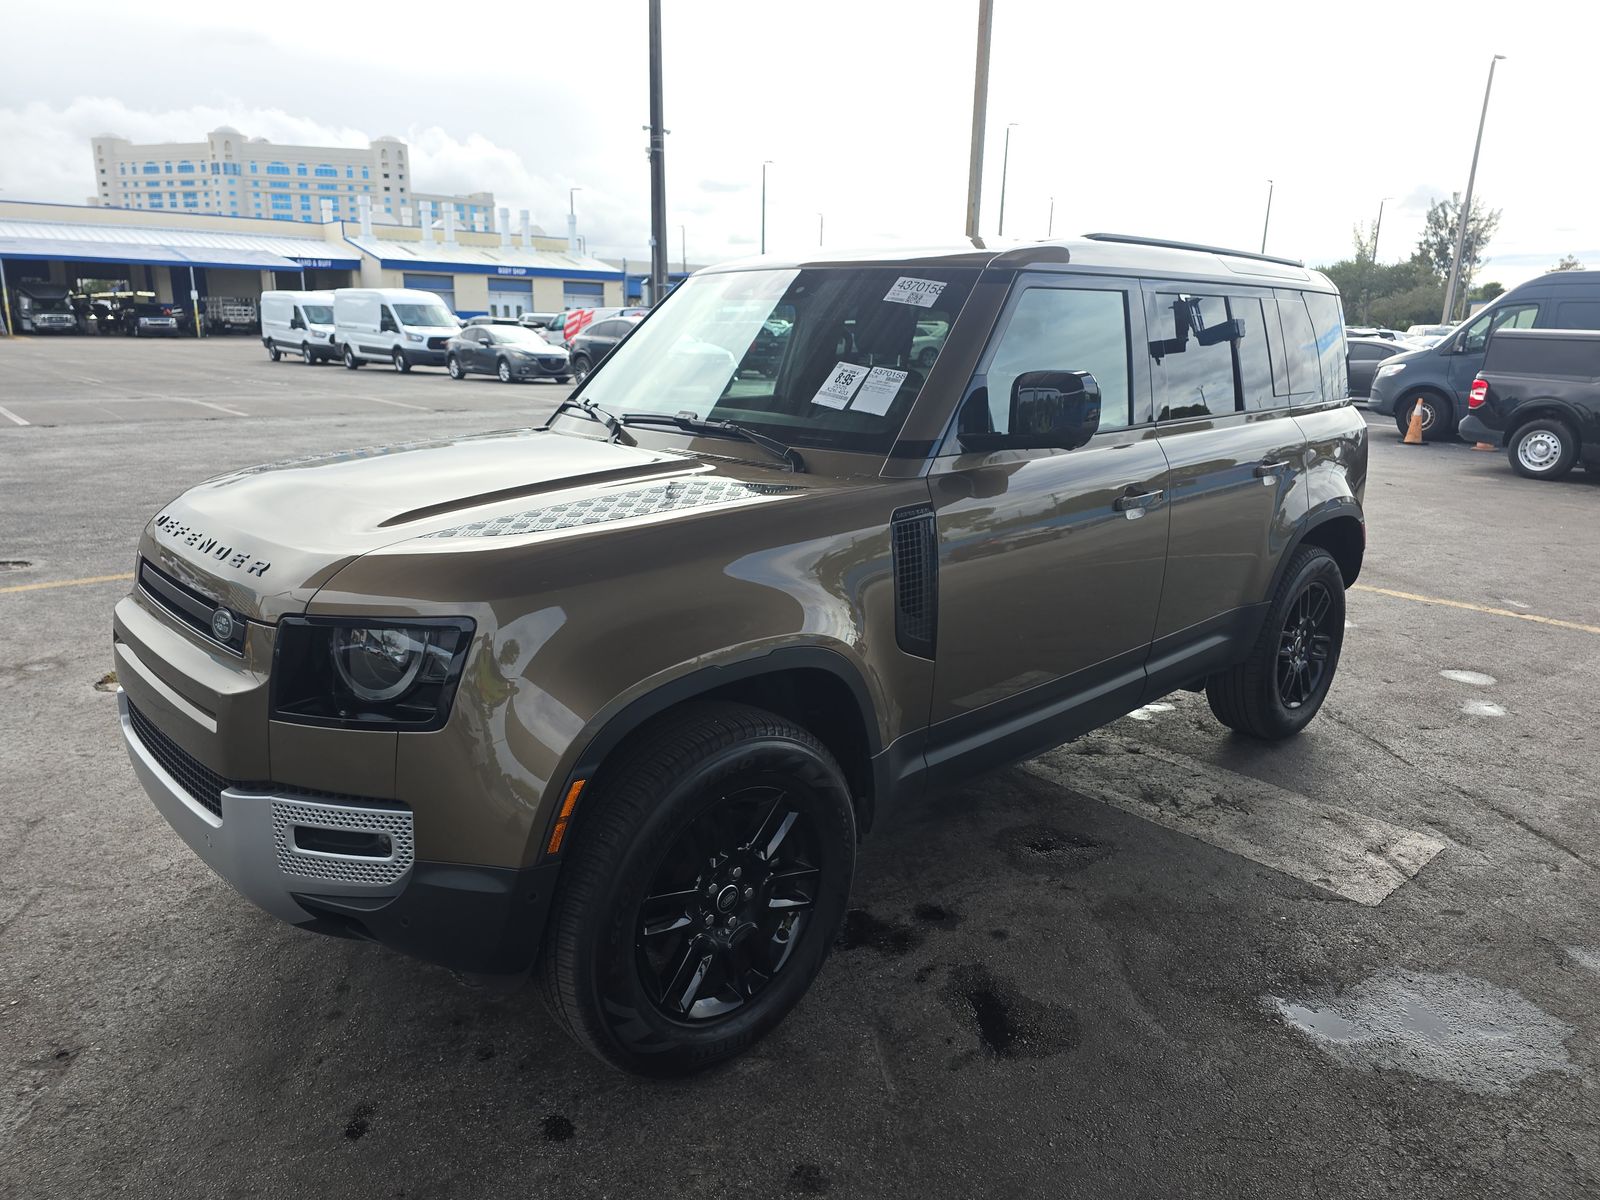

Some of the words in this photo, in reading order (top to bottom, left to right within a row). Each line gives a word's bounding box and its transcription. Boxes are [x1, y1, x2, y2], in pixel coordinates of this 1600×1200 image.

[497, 266, 512, 275] BODY
[512, 267, 528, 276] SHOP
[897, 279, 945, 295] 4370158
[156, 514, 271, 577] DEFENDER
